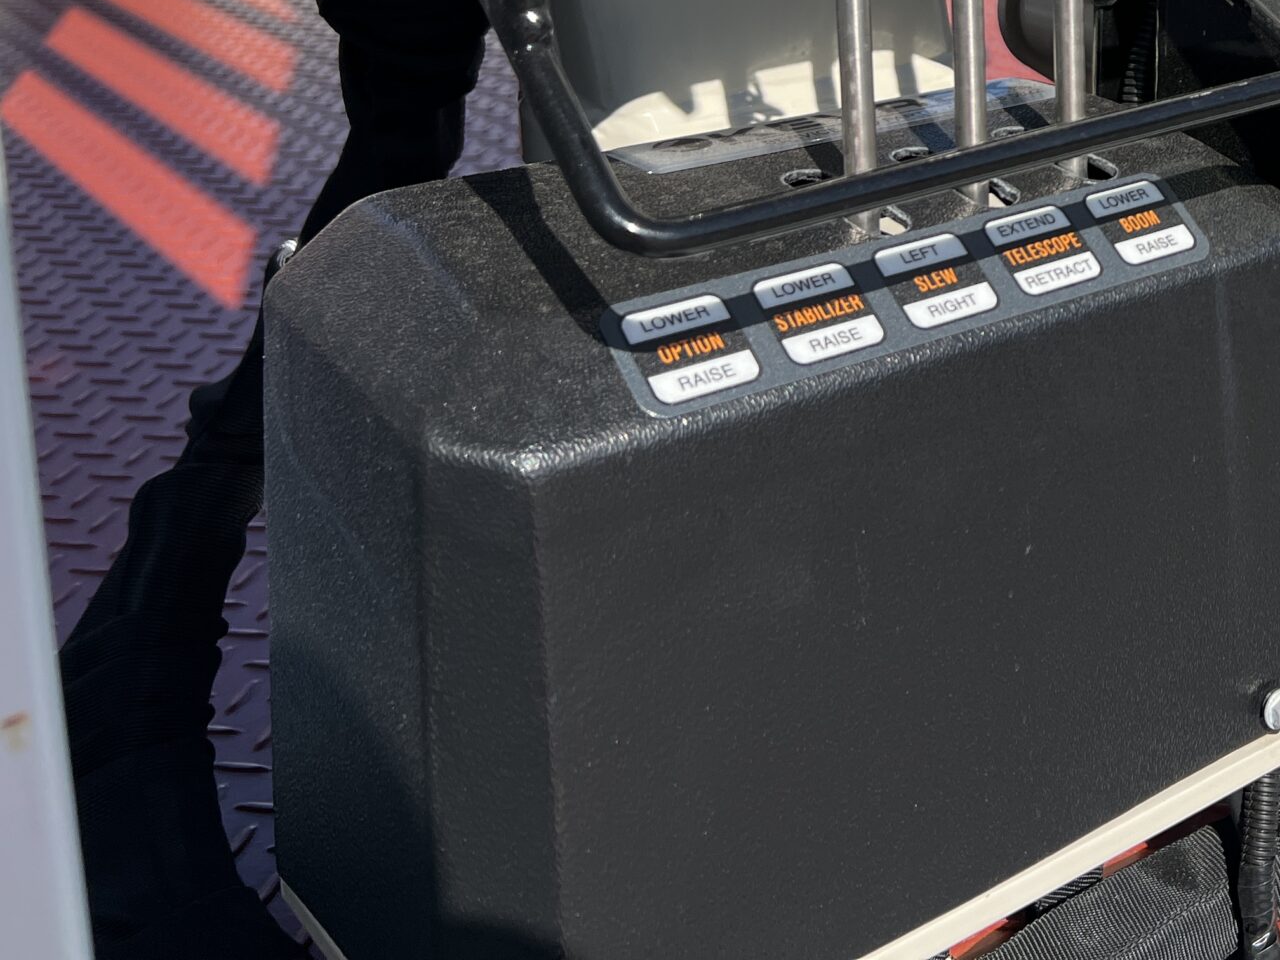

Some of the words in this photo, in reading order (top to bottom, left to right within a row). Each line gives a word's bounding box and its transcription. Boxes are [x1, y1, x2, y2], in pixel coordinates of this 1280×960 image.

[1098, 189, 1150, 211] LOWER
[997, 213, 1056, 238] EXTEND
[1119, 210, 1161, 234] BOOM
[900, 244, 939, 265] LEFT
[1003, 231, 1082, 267] TELESCOPE
[1136, 234, 1178, 255] RAISE
[771, 272, 836, 299] LOWER
[914, 268, 958, 293] SLEW
[1025, 259, 1095, 289] RETRACT
[639, 305, 711, 334] LOWER
[773, 294, 865, 333] STABILIZER
[927, 294, 976, 319] RIGHT
[657, 331, 726, 365] OPTION
[809, 327, 863, 353] RAISE
[677, 363, 737, 392] RAISE
